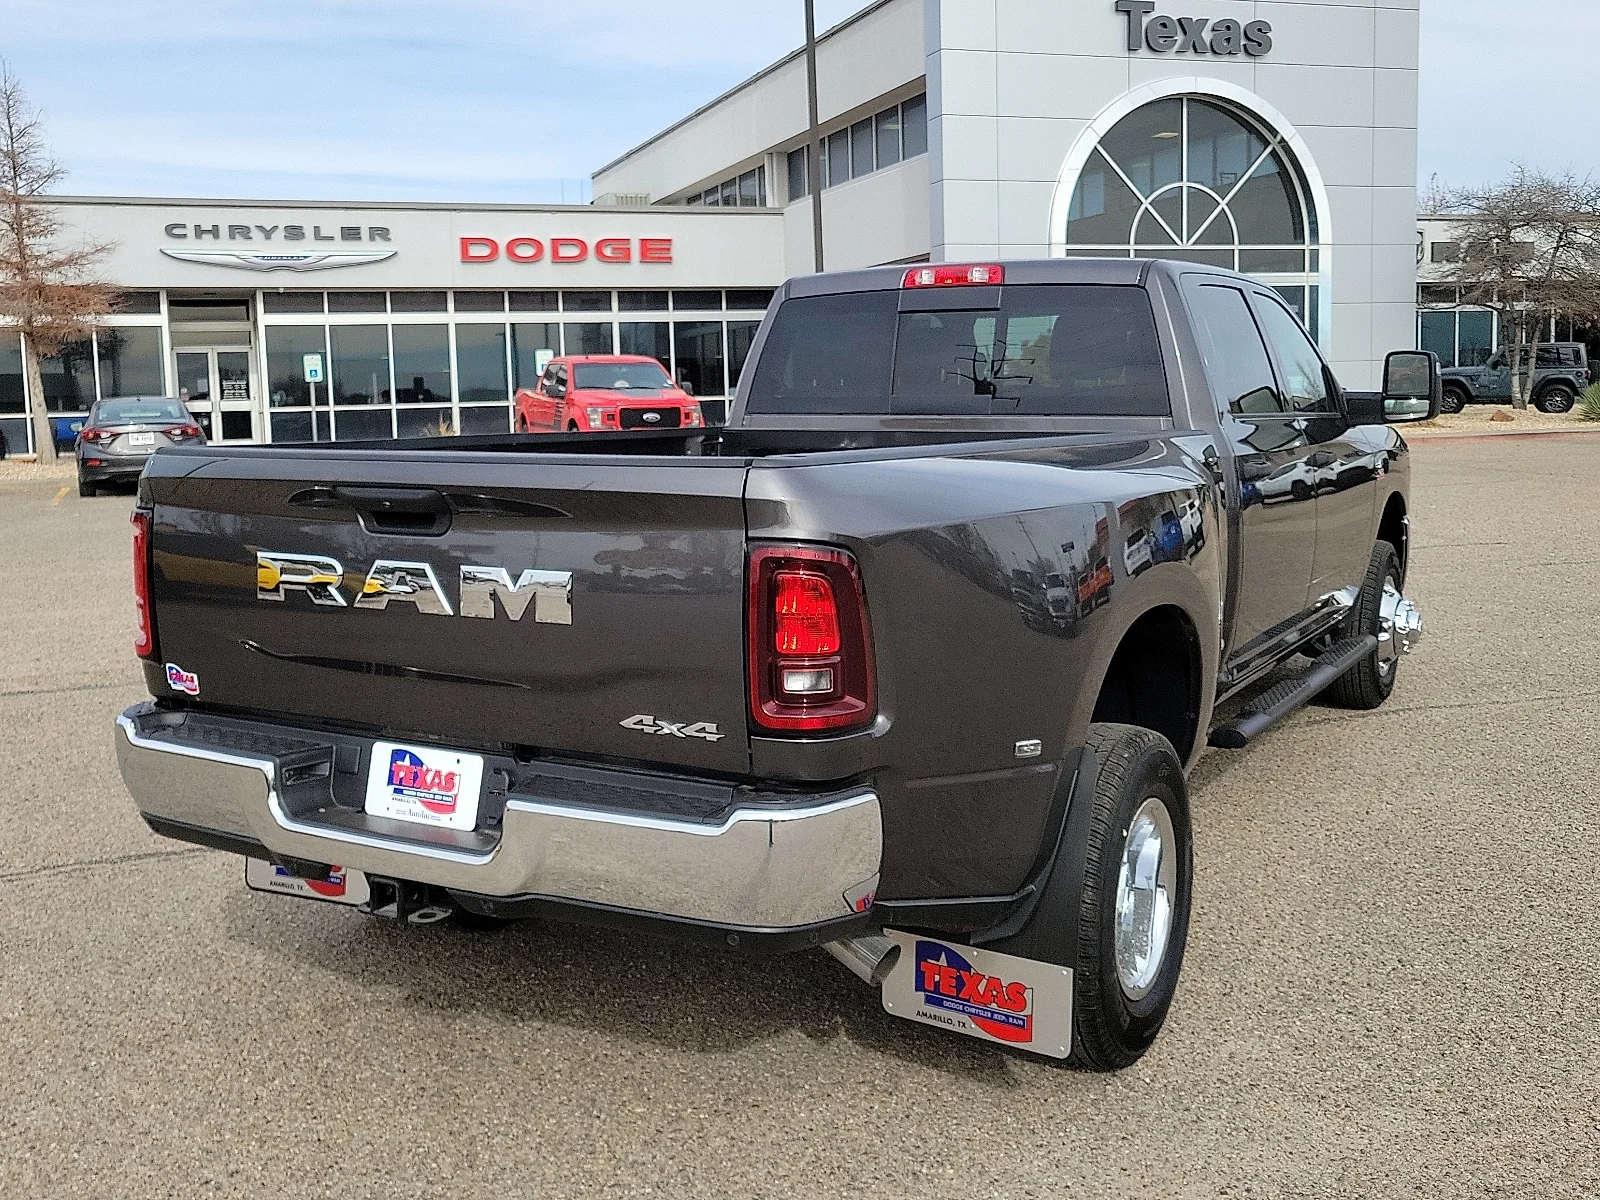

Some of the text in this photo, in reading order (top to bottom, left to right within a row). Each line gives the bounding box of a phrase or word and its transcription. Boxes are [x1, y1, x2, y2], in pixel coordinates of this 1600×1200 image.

[1115, 0, 1272, 56] Texas
[164, 223, 392, 242] CHRYSLER
[459, 237, 673, 263] DODGE
[257, 551, 574, 625] RAM
[391, 763, 456, 792] TEXAS
[920, 961, 1027, 1013] TEXAS
[943, 1000, 963, 1011] DODGE
[964, 1006, 992, 1018] CHRYSLER
[1008, 1016, 1024, 1026] RAM
[957, 1020, 967, 1029] TX
